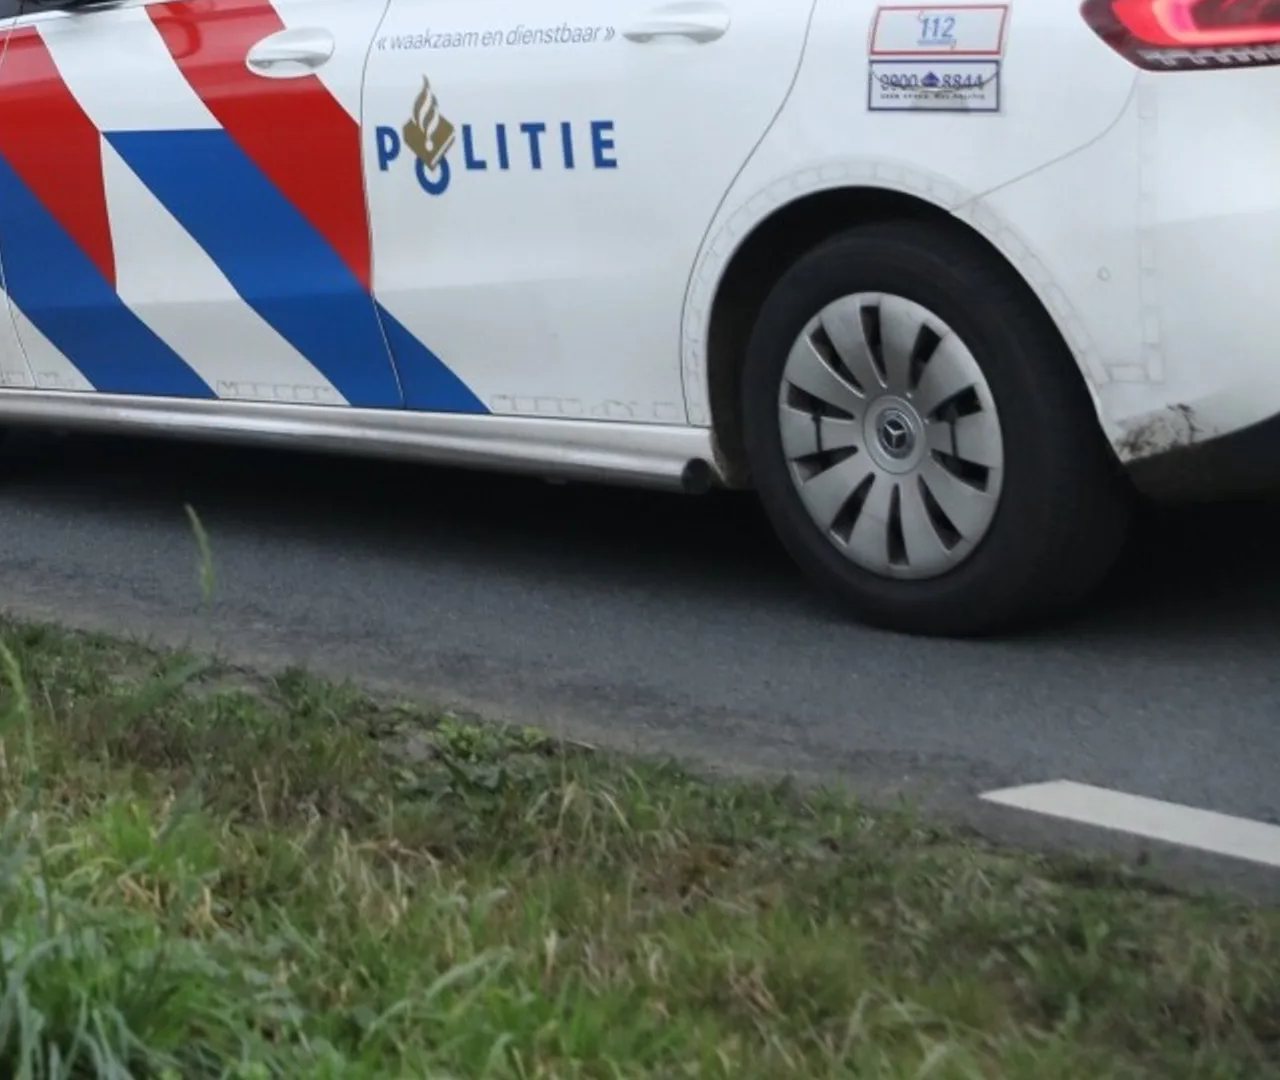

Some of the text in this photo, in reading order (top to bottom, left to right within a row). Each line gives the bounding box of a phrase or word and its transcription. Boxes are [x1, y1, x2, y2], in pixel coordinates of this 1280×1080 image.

[390, 28, 479, 51] waakzaam
[481, 31, 505, 47] en
[506, 22, 603, 46] dienstbaar
[921, 15, 956, 38] 112
[375, 110, 619, 196] POLITIE
